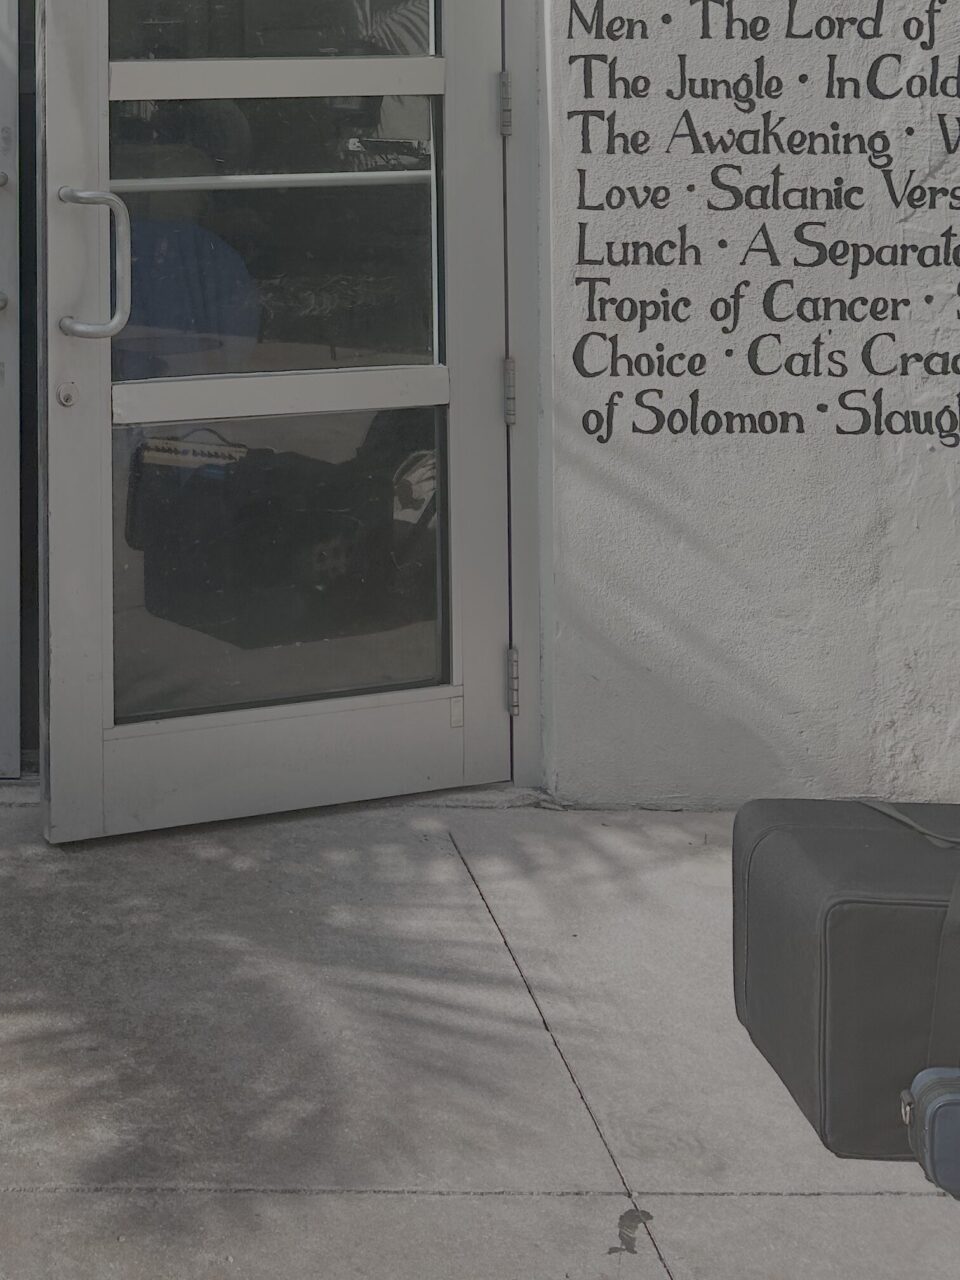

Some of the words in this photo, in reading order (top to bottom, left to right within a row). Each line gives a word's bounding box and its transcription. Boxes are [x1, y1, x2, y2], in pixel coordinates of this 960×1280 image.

[568, 54, 651, 99] The
[665, 54, 783, 114] Jungle
[825, 54, 861, 99] In
[567, 110, 651, 156] The
[577, 169, 671, 211] Love
[707, 163, 865, 211] Satanic
[575, 222, 702, 267] Lunch
[739, 222, 781, 266] A
[575, 277, 691, 333] Tropic
[710, 280, 751, 334] of
[762, 279, 910, 323] Cancer
[572, 331, 706, 378] Choice
[745, 329, 848, 377] Cat's
[582, 391, 624, 444] of
[632, 389, 805, 435] Solomon
[836, 387, 960, 447] Slaug
